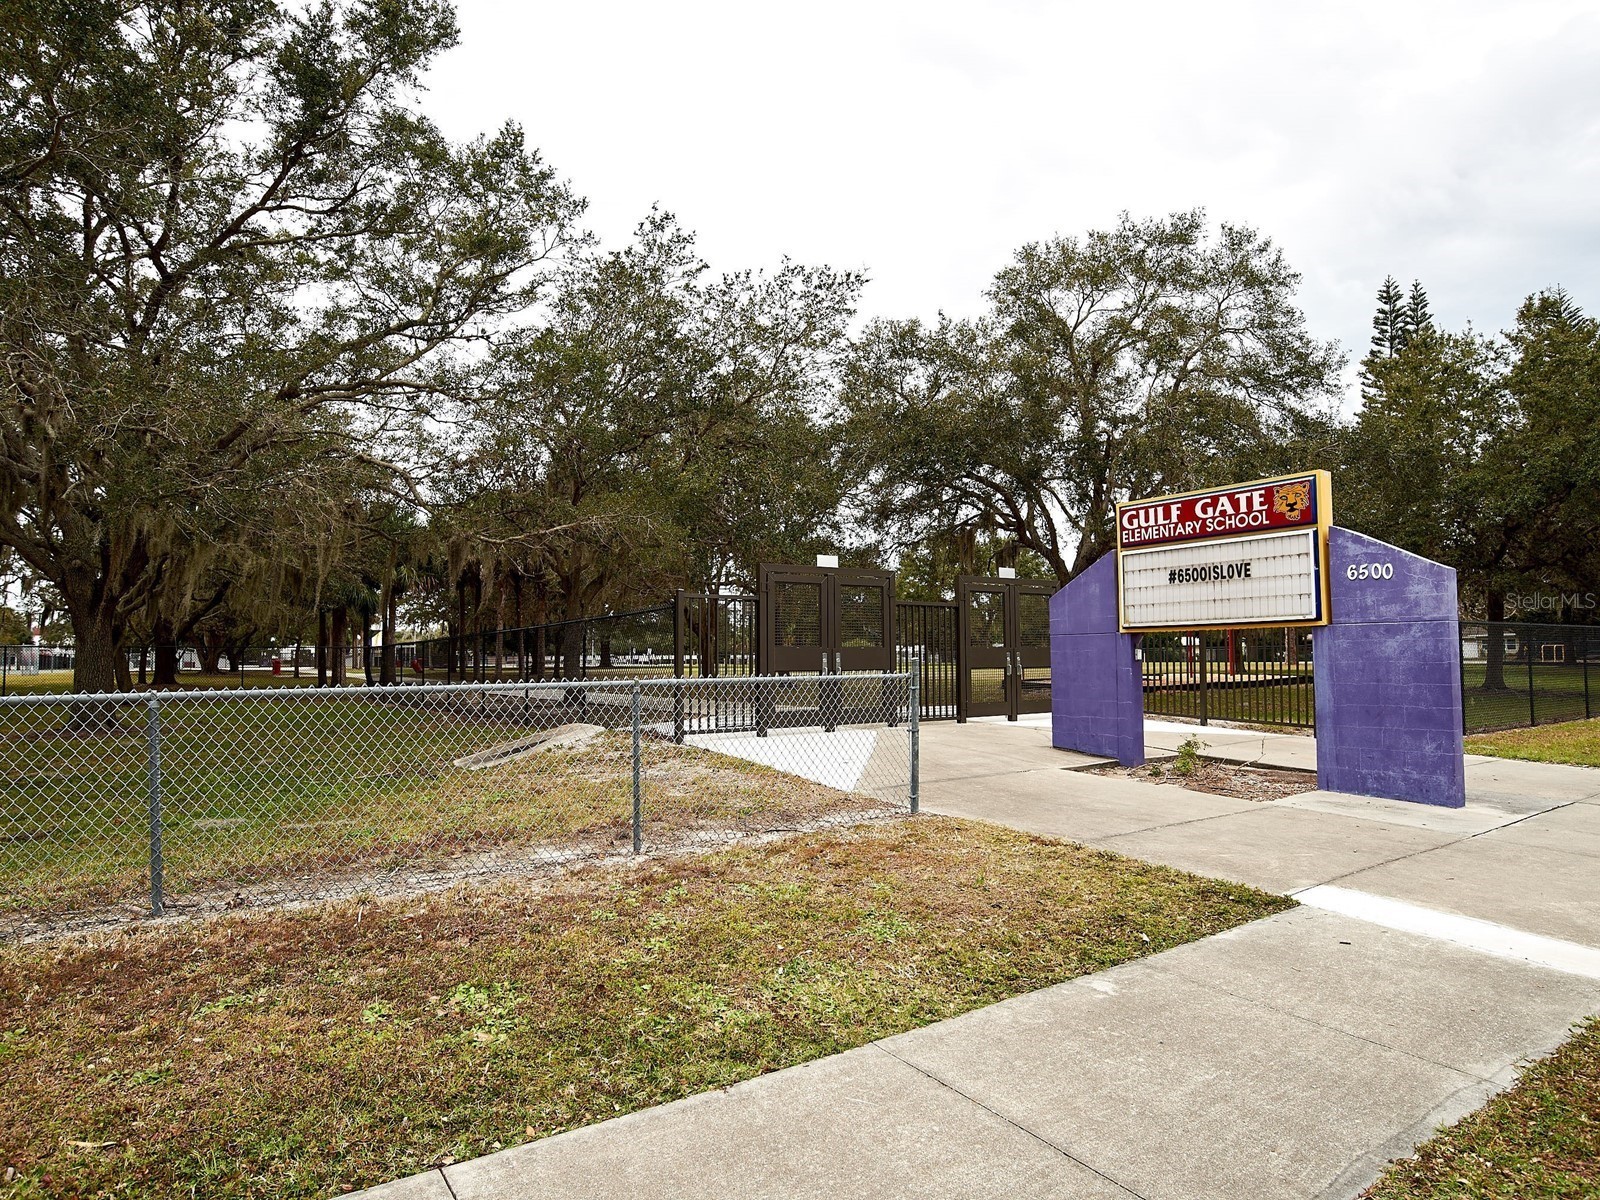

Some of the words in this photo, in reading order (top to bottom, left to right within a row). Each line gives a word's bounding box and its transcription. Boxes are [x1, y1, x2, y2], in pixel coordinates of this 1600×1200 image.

[1122, 503, 1182, 530] GULF
[1195, 489, 1268, 519] GATE
[1122, 519, 1201, 543] ELEMENTARY
[1206, 510, 1269, 532] SCHOOL
[1168, 562, 1251, 584] #6500ISLOVE
[1347, 562, 1394, 581] 6500
